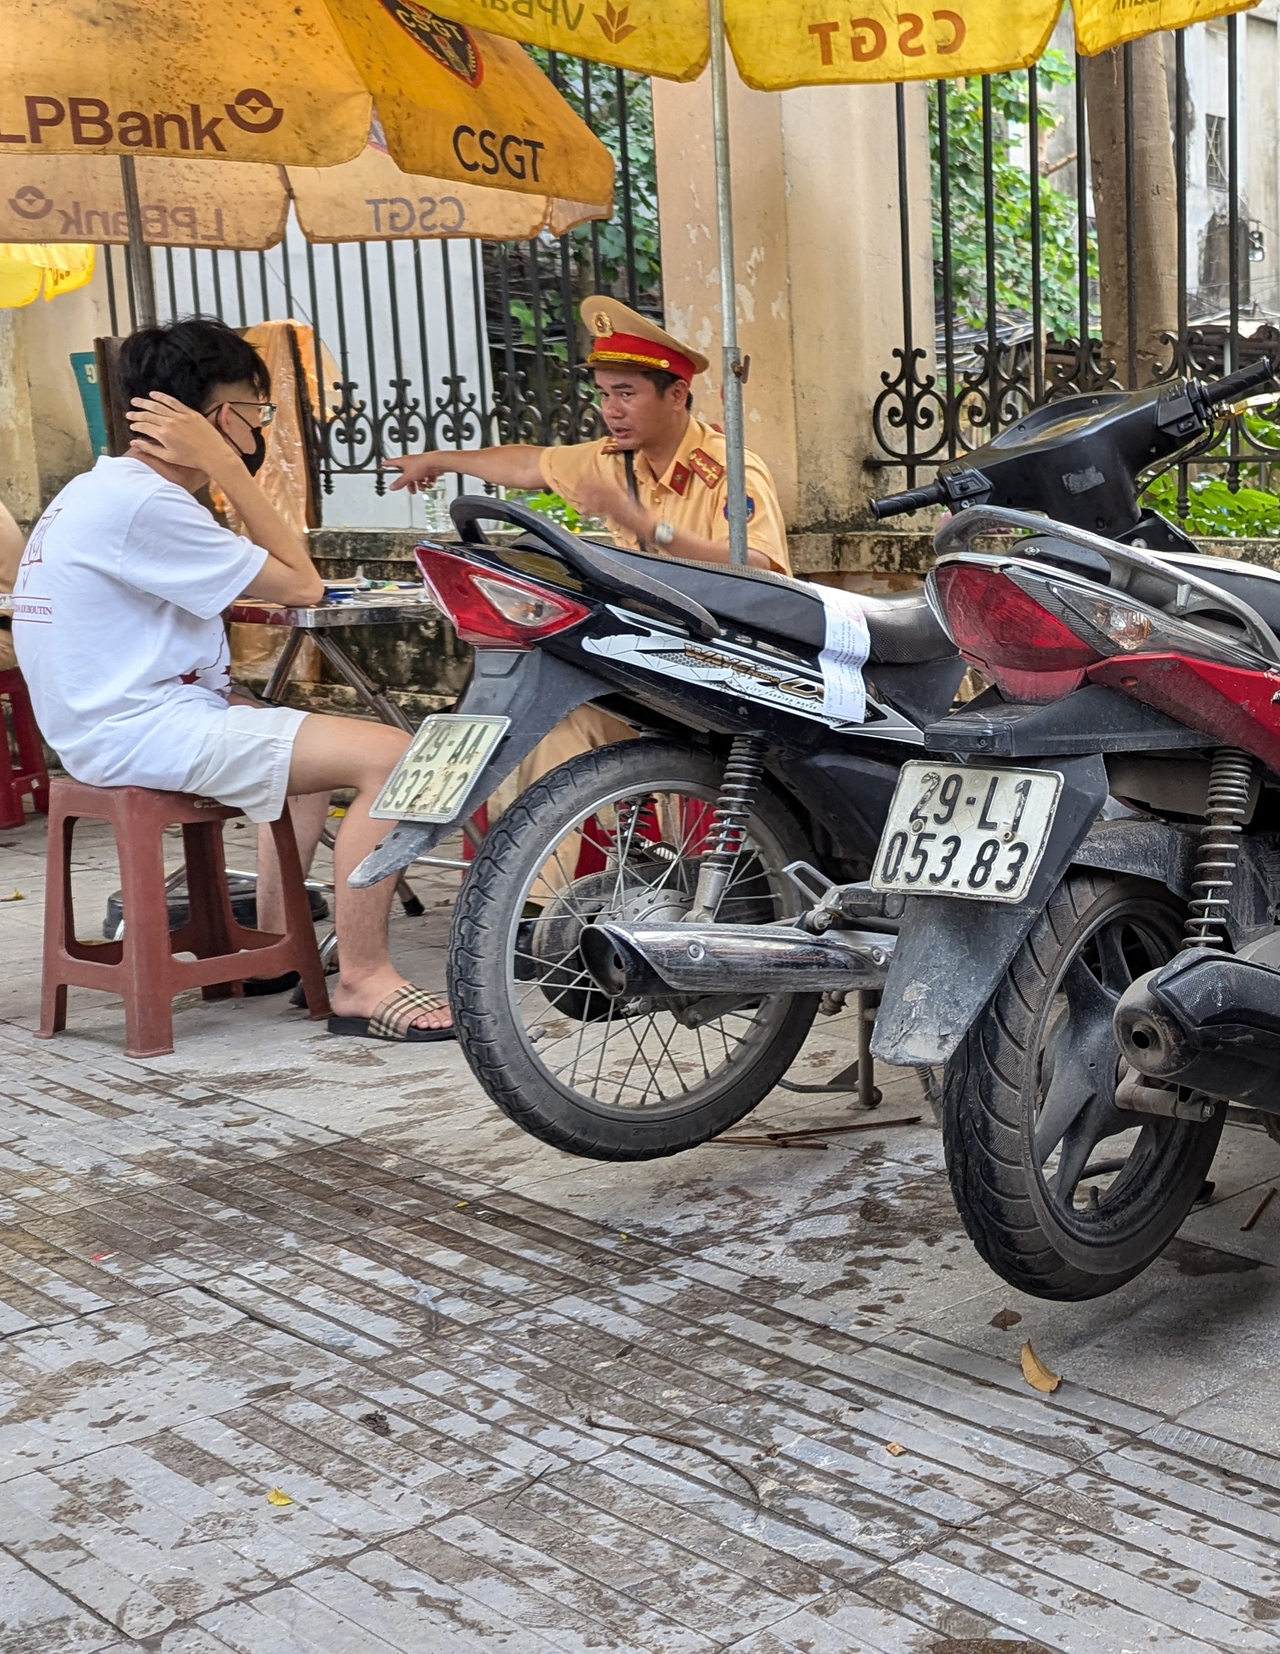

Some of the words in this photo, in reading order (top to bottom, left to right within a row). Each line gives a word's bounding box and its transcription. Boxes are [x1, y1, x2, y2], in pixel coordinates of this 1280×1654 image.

[395, 8, 464, 42] CSGT
[452, 124, 545, 183] CSGT
[412, 722, 489, 765] 29-AA
[909, 772, 1032, 832] 29-L1
[881, 832, 1030, 892] 053.83
